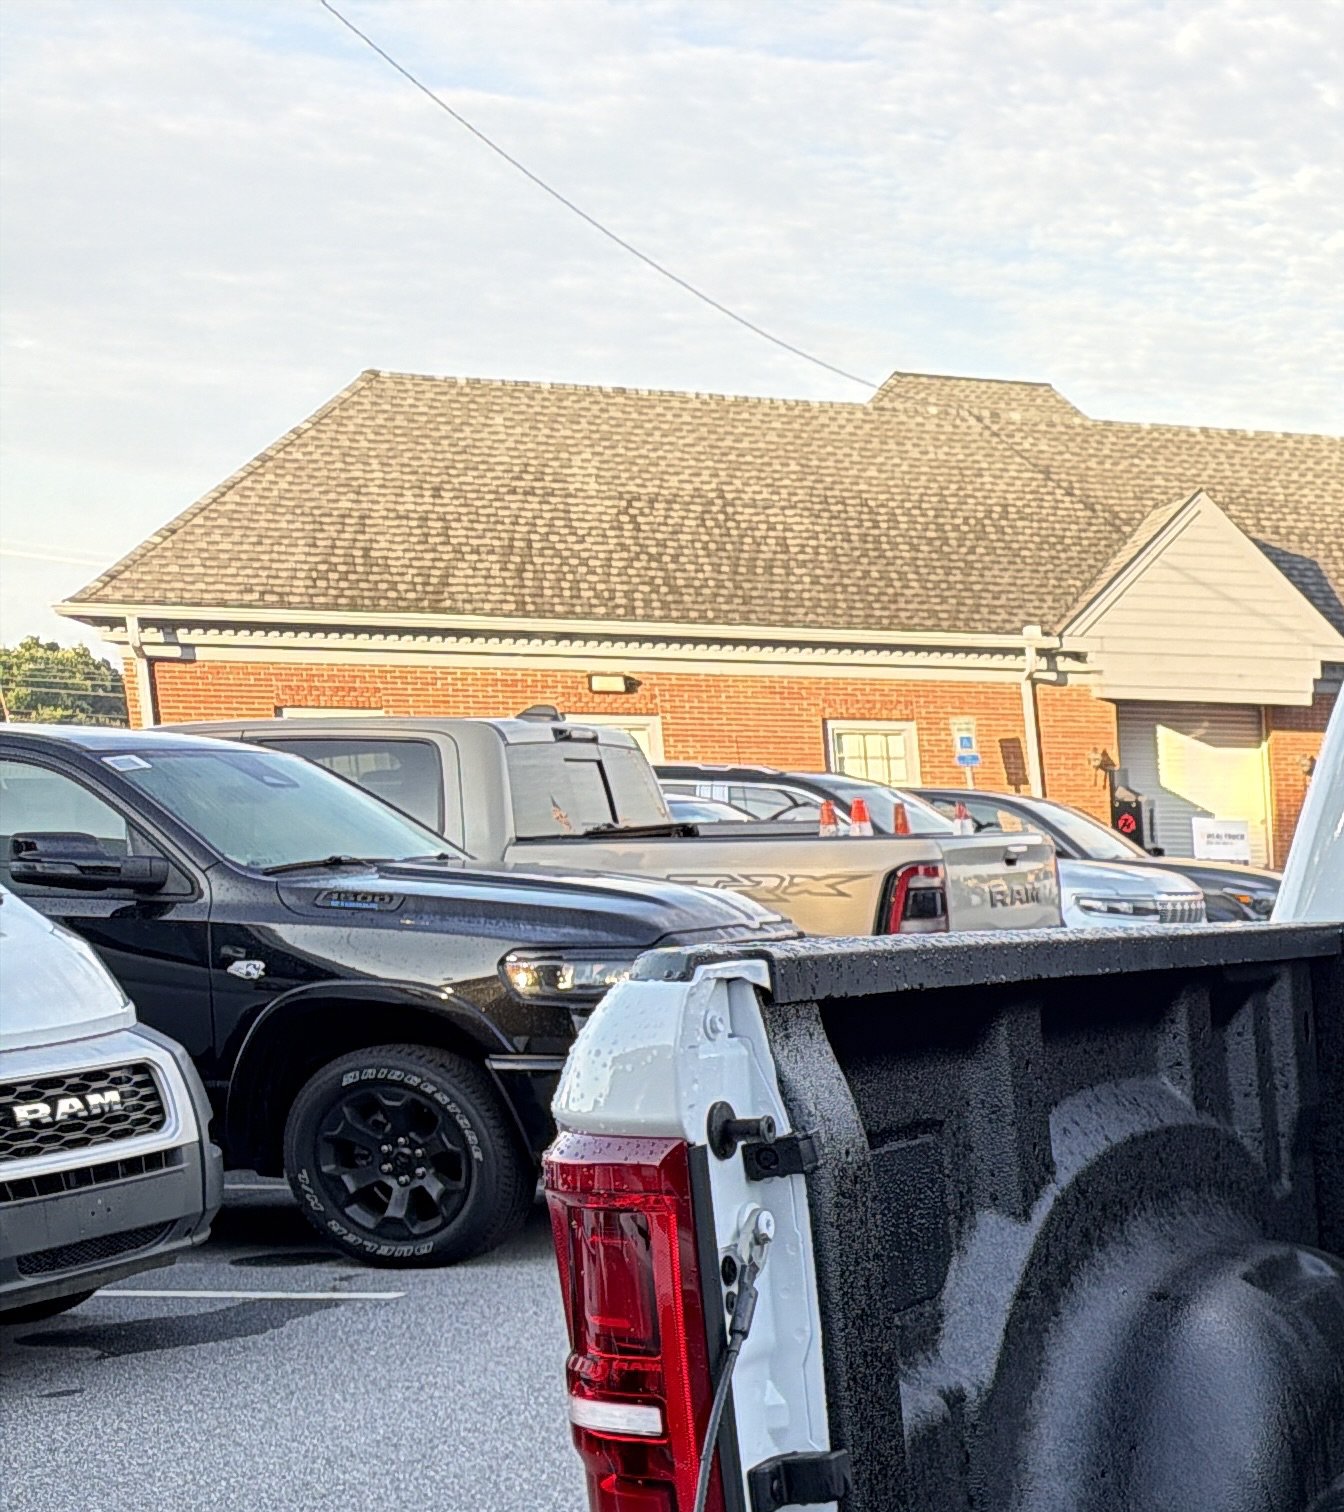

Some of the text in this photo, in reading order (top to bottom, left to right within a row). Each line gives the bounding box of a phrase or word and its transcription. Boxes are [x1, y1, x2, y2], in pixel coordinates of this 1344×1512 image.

[988, 884, 1041, 909] RAM
[12, 1090, 123, 1127] RAM
[341, 1067, 484, 1163] BRIDGESTONE
